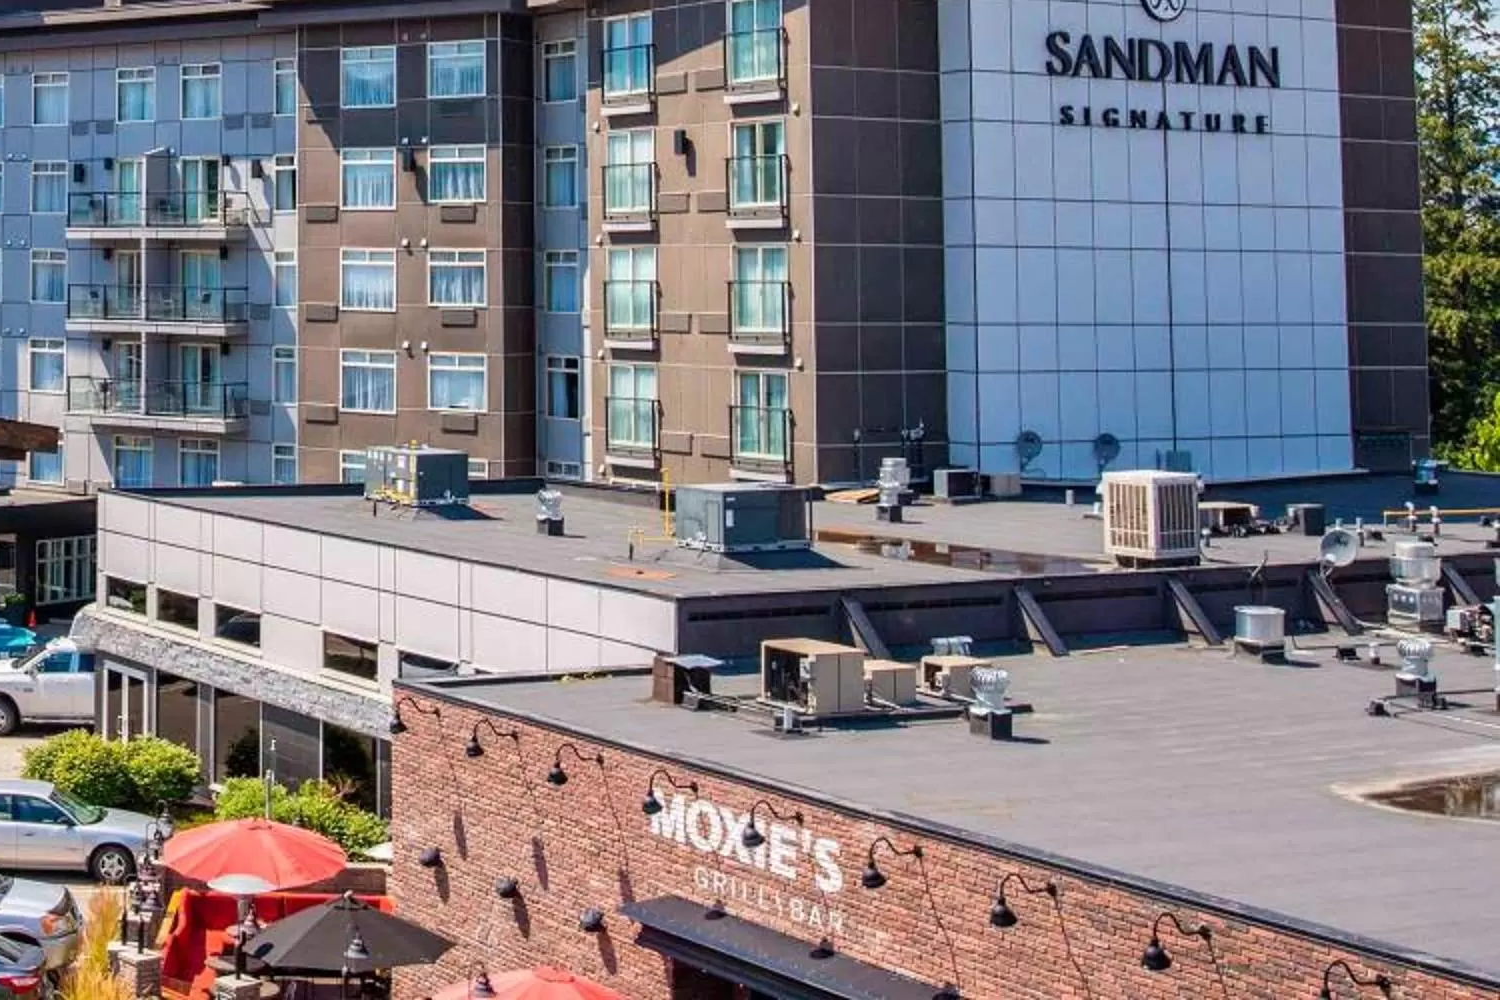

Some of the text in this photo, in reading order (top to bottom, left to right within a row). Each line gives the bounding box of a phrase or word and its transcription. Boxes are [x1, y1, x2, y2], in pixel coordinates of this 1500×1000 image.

[1045, 31, 1281, 89] SANDMAN
[1059, 105, 1270, 134] SIGNATURE
[649, 788, 843, 893] MOXIE'S
[694, 866, 770, 909] GRILL
[789, 897, 844, 932] BAR
